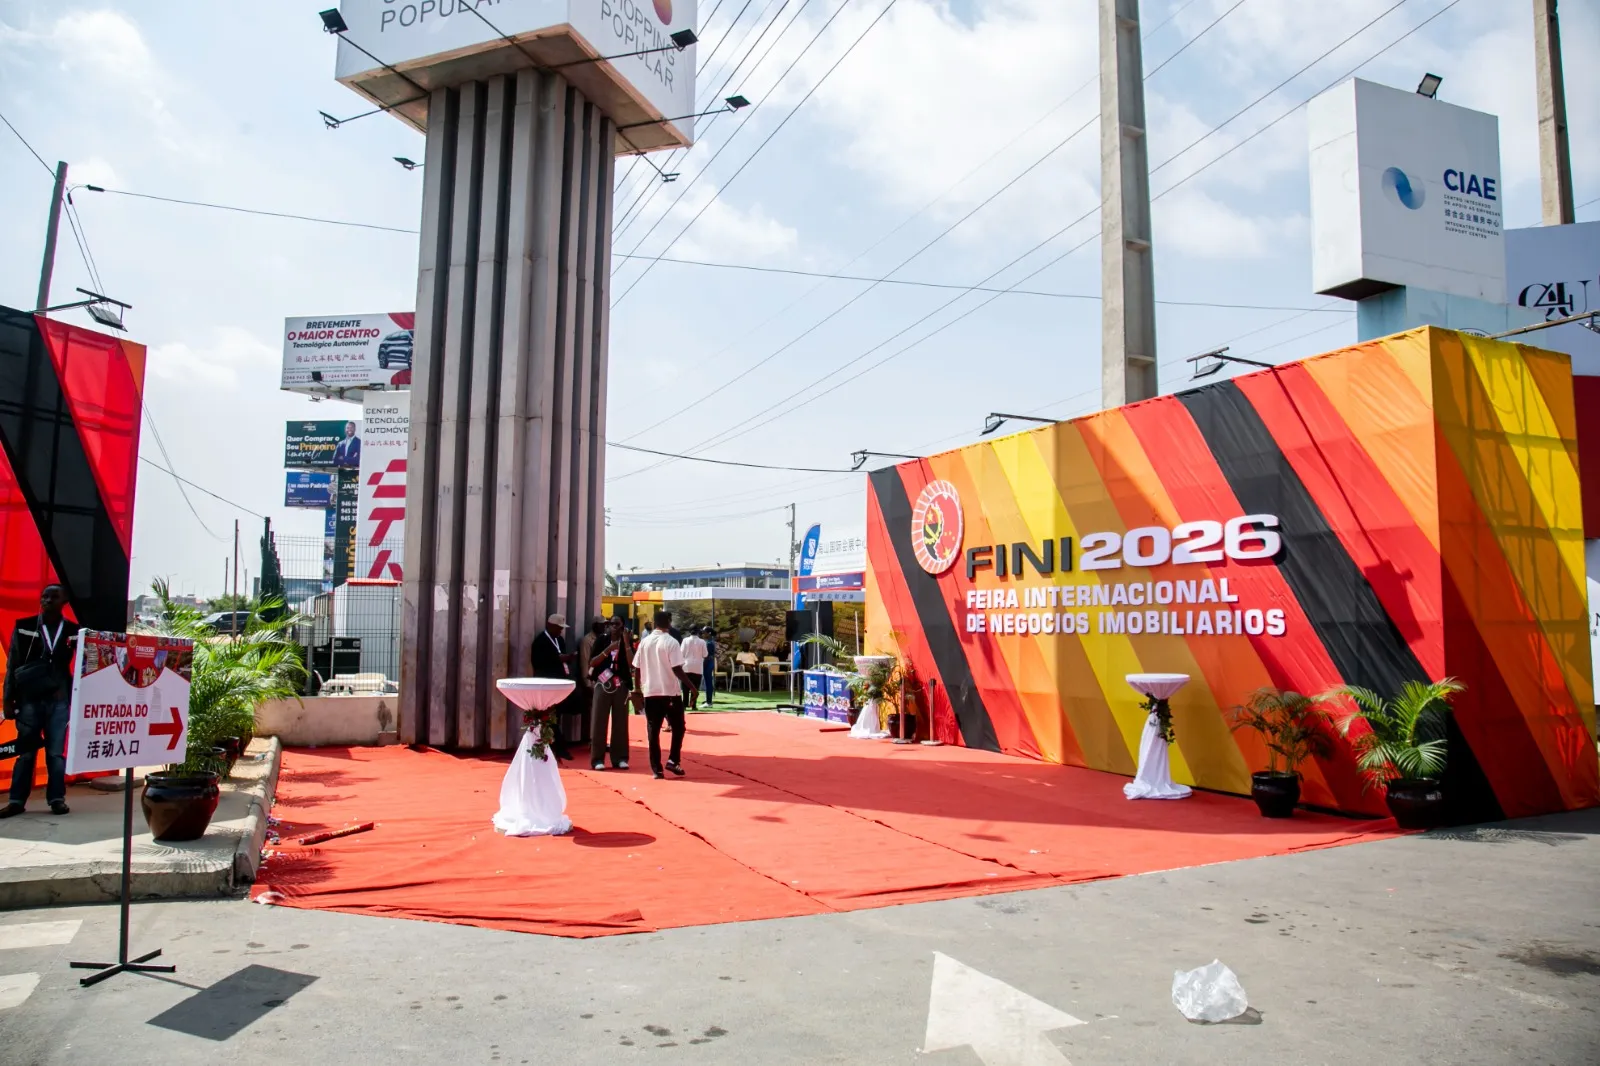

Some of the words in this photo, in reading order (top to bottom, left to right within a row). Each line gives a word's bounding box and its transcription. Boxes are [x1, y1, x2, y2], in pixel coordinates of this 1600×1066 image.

[381, 0, 500, 32] POPUL
[601, 1, 674, 94] POPULAR
[1443, 168, 1497, 201] CIAE
[1444, 194, 1463, 202] CENTRO
[1464, 199, 1492, 209] INTEGRADO
[1476, 208, 1501, 217] EMPRESAS
[1444, 220, 1475, 230] INTEGRATED
[1476, 227, 1500, 236] BUSINESS
[1445, 226, 1468, 235] SUPPORT
[1469, 231, 1488, 240] CENTER
[306, 320, 362, 329] BREVEMENTE
[287, 332, 296, 340] O
[298, 330, 334, 340] MAIOR
[336, 328, 380, 339] CENTRO
[293, 341, 332, 349] Tecnológico
[965, 536, 1073, 580] FINI
[1079, 513, 1282, 572] 2026
[966, 587, 1019, 610] FEIRA
[1024, 577, 1239, 609] INTERNACIONAL
[966, 613, 986, 634] DE
[990, 610, 1090, 635] NEGOCIOS
[1098, 608, 1287, 637] IMOBILIARIOS
[84, 704, 132, 718] ENTRADA
[134, 703, 148, 718] DO
[95, 720, 136, 736] EVENTO
[87, 740, 140, 759] 活动入口
